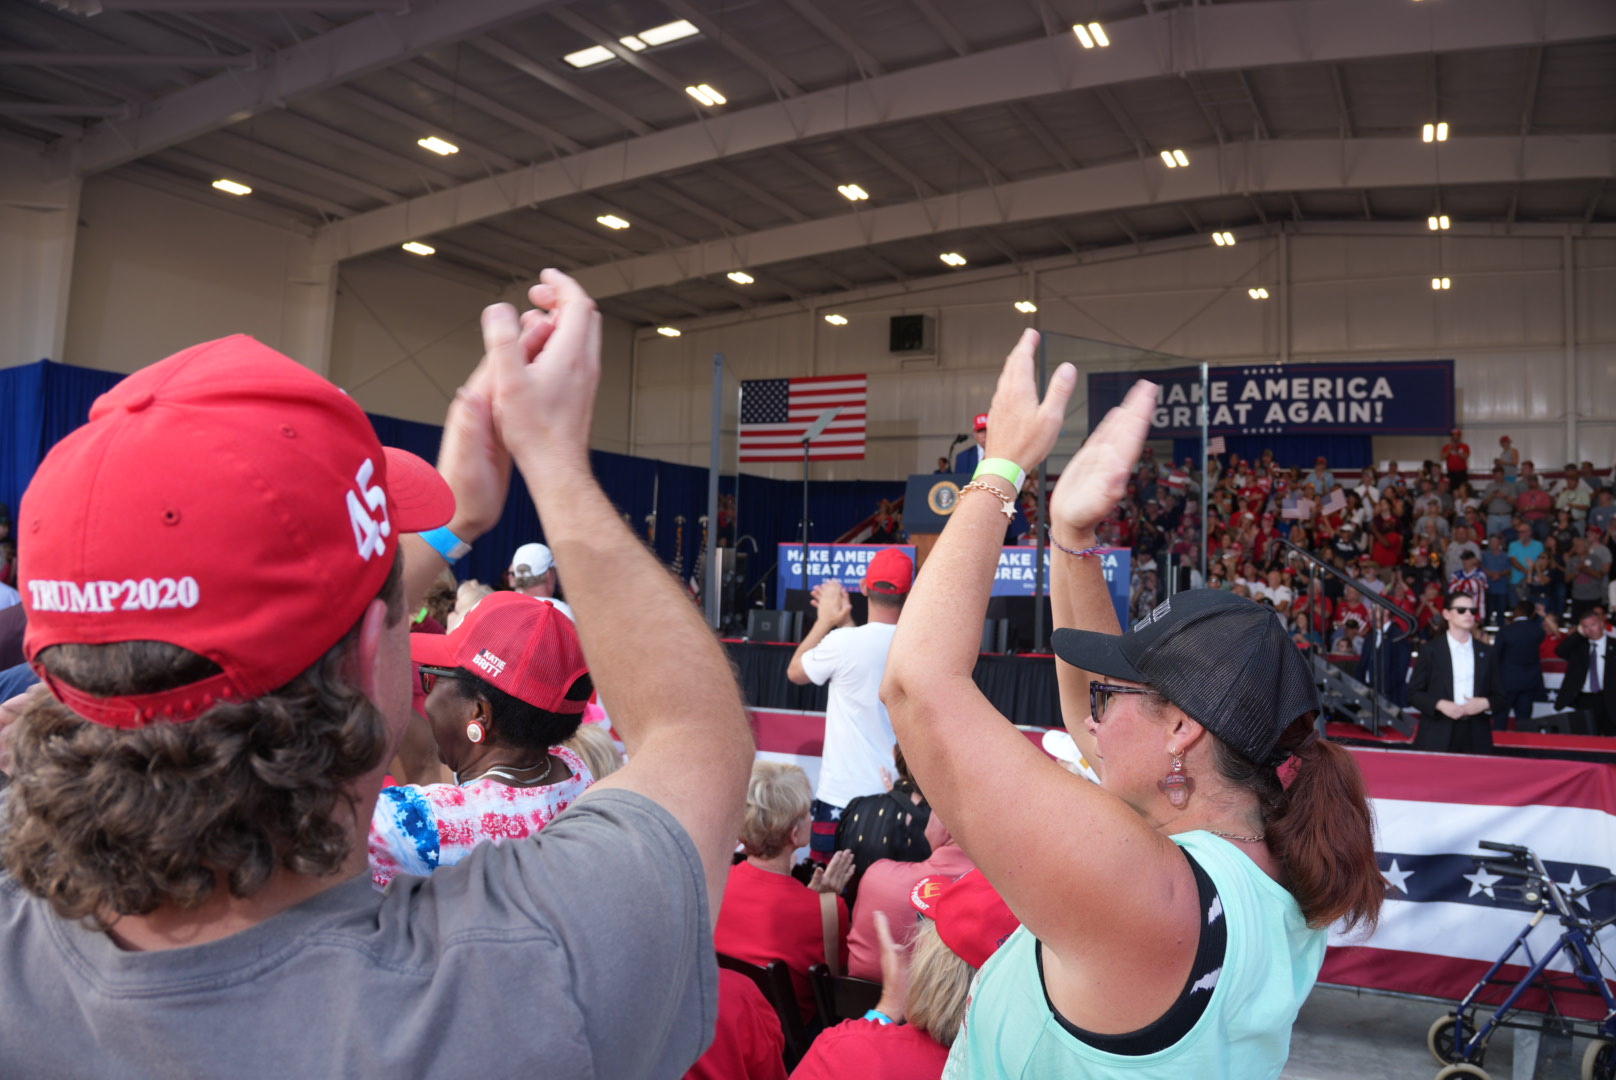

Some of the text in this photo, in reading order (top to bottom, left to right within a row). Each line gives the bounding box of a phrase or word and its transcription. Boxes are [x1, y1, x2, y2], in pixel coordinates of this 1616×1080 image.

[1157, 377, 1394, 405] AKE AMERICA
[1151, 401, 1383, 428] GREAT AGAIN!
[346, 458, 391, 561] 45
[833, 550, 877, 563] AMER
[998, 553, 1032, 566] AKE
[472, 653, 502, 677] BRITT
[483, 650, 507, 671] KATIE
